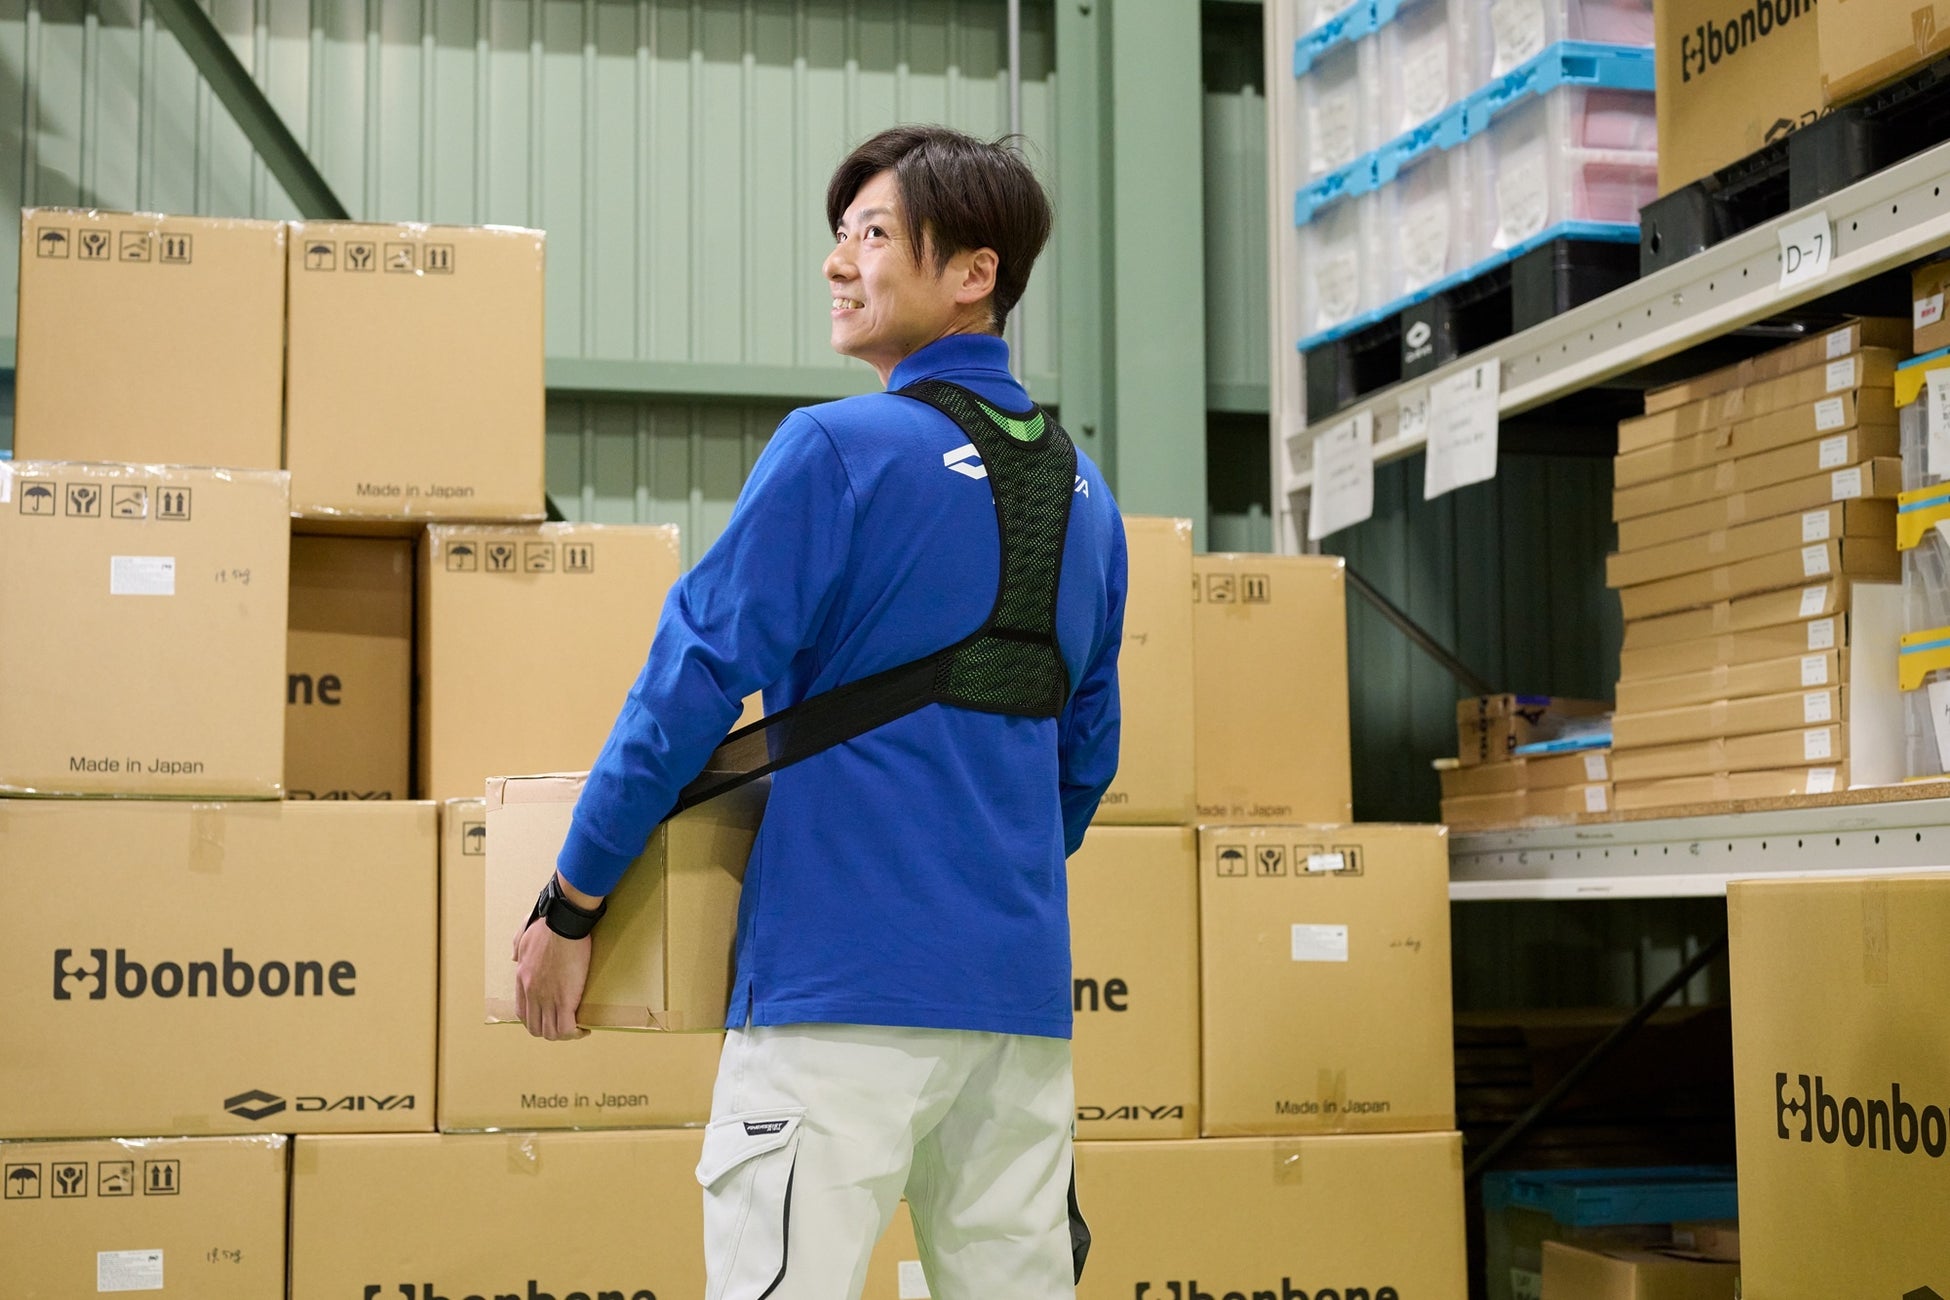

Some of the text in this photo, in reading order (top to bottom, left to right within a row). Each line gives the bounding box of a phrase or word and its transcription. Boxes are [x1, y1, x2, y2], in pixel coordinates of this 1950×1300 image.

[1787, 233, 1823, 274] D-7
[356, 481, 475, 500] Made in Japan
[69, 755, 204, 775] Made in Japan
[1248, 803, 1293, 818] Japan
[115, 948, 357, 999] bonbone
[296, 1094, 415, 1112] DAIYA
[521, 1091, 649, 1109] Made in Japan
[1276, 1098, 1391, 1115] Made in Japan
[1077, 1105, 1184, 1121] DAIYA
[1815, 1075, 1950, 1159] bonbo
